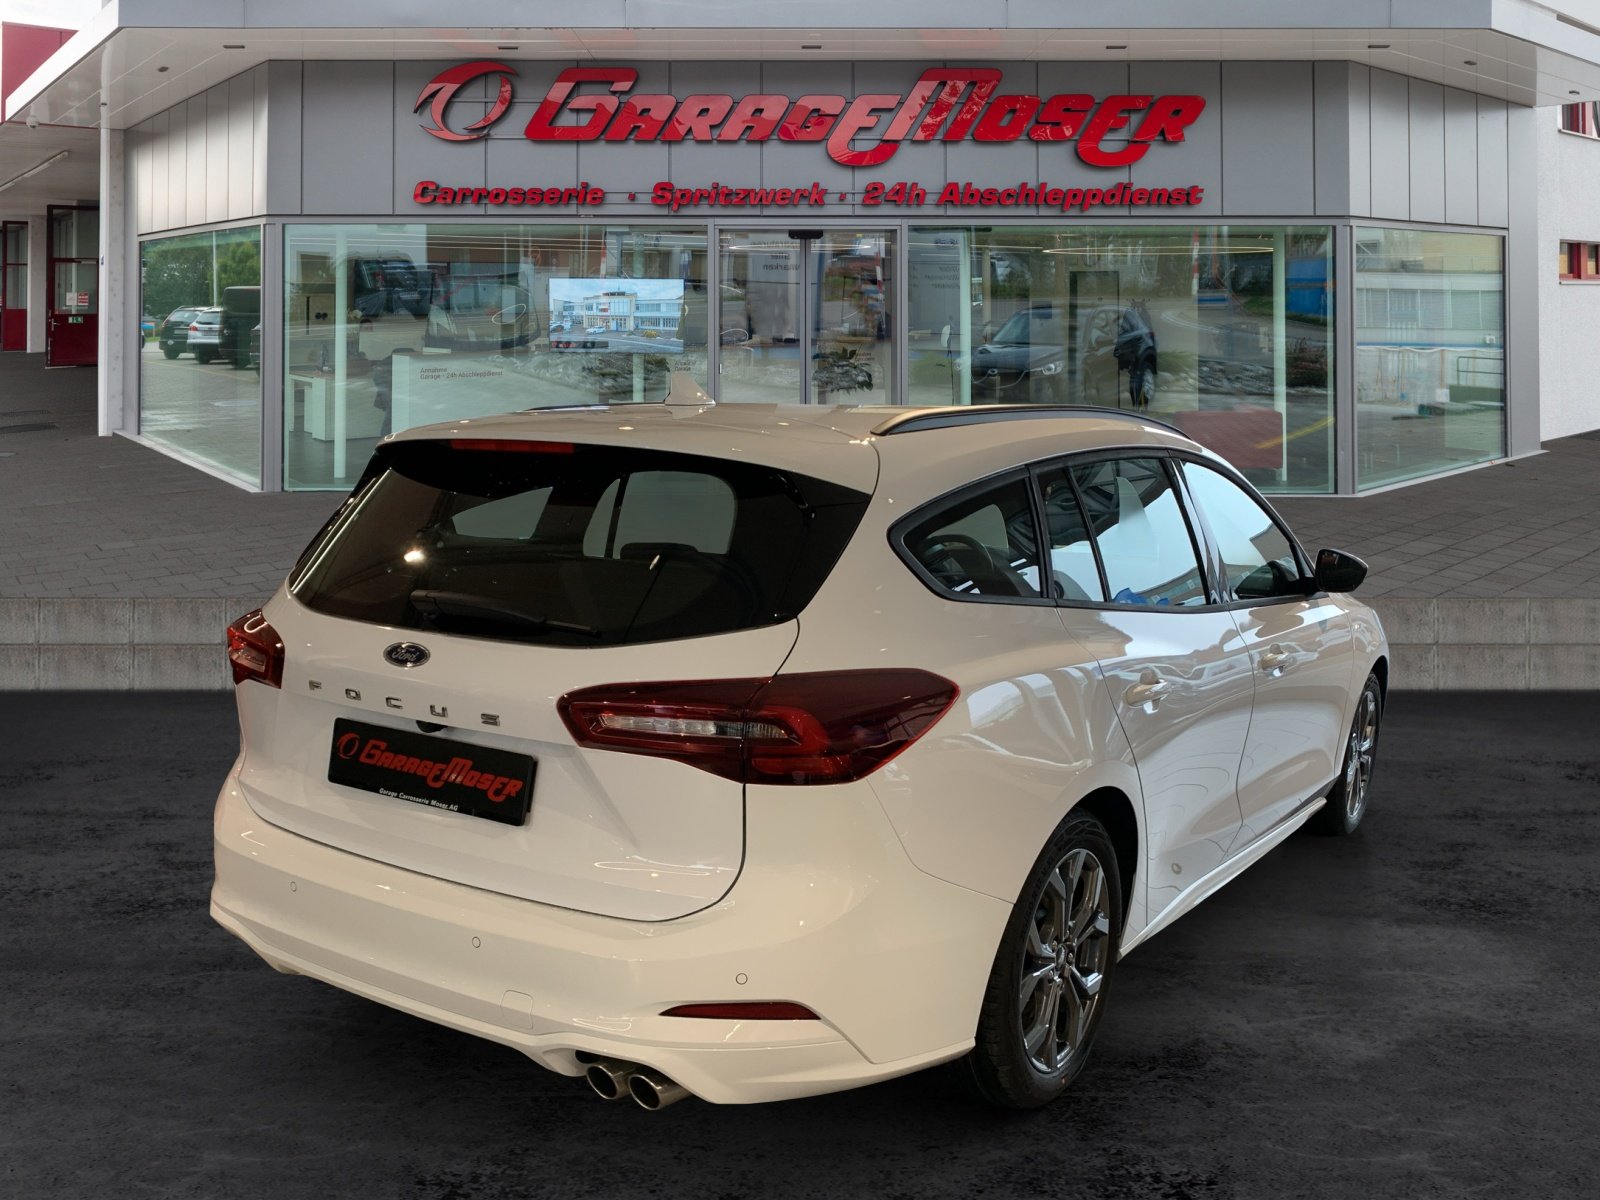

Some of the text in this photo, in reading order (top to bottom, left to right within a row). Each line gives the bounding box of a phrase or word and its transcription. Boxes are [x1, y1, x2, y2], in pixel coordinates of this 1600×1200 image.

[412, 180, 1204, 213] Carrosserie Spritzwerk 24h Abschleppdienst
[420, 373, 441, 381] Garage
[308, 679, 500, 727] FOCUS
[379, 787, 459, 812] Garage Carrosserie Moser AG
